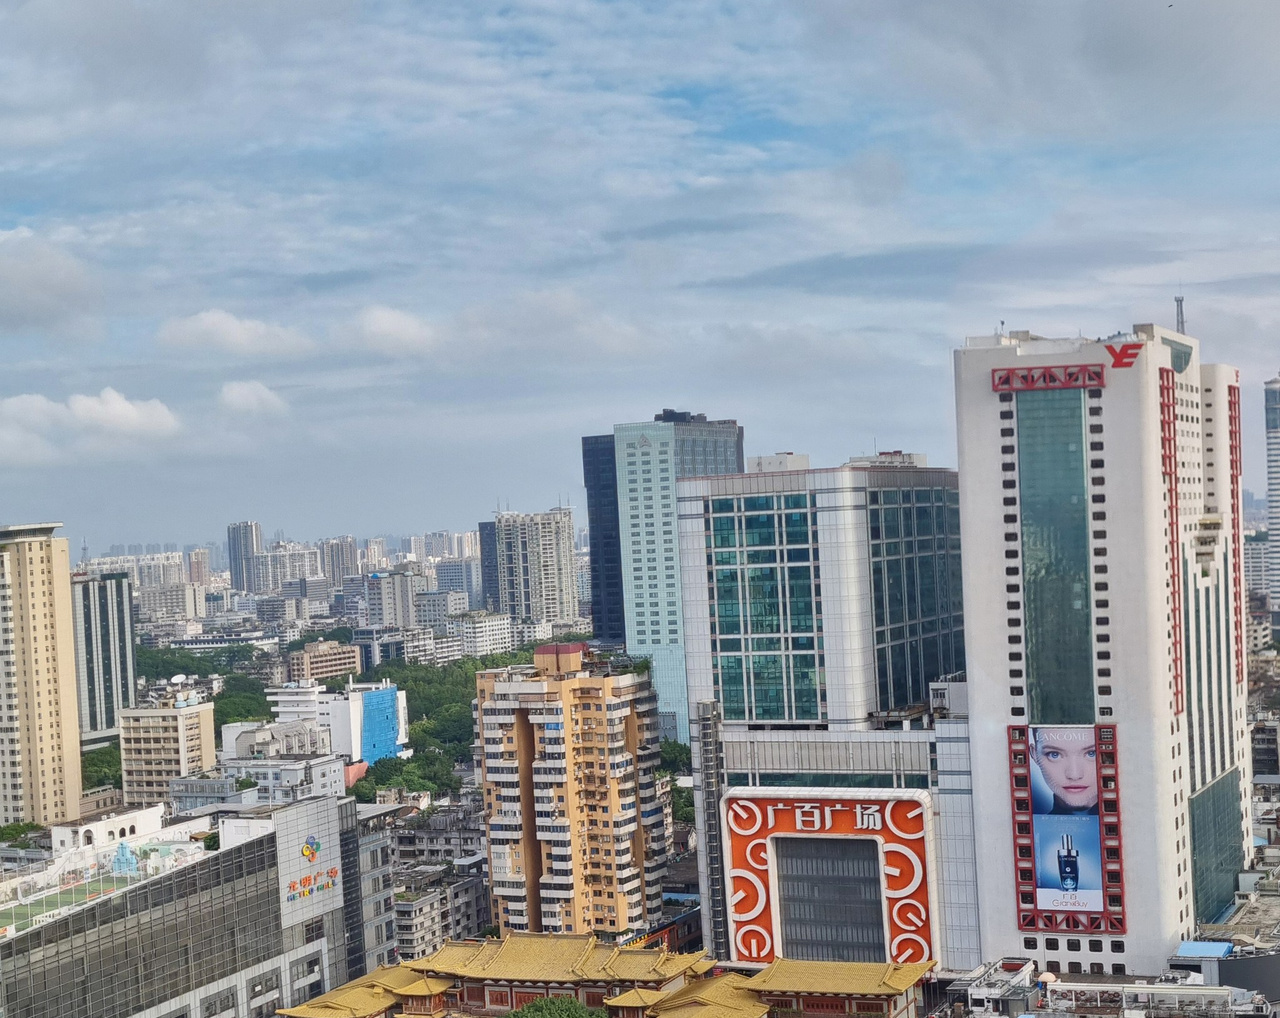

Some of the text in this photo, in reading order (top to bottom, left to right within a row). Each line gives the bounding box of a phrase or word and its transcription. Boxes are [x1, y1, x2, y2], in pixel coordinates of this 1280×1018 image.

[766, 802, 883, 831] 广百广场
[286, 879, 338, 902] METRO MALL
[287, 866, 339, 894] 光明广场
